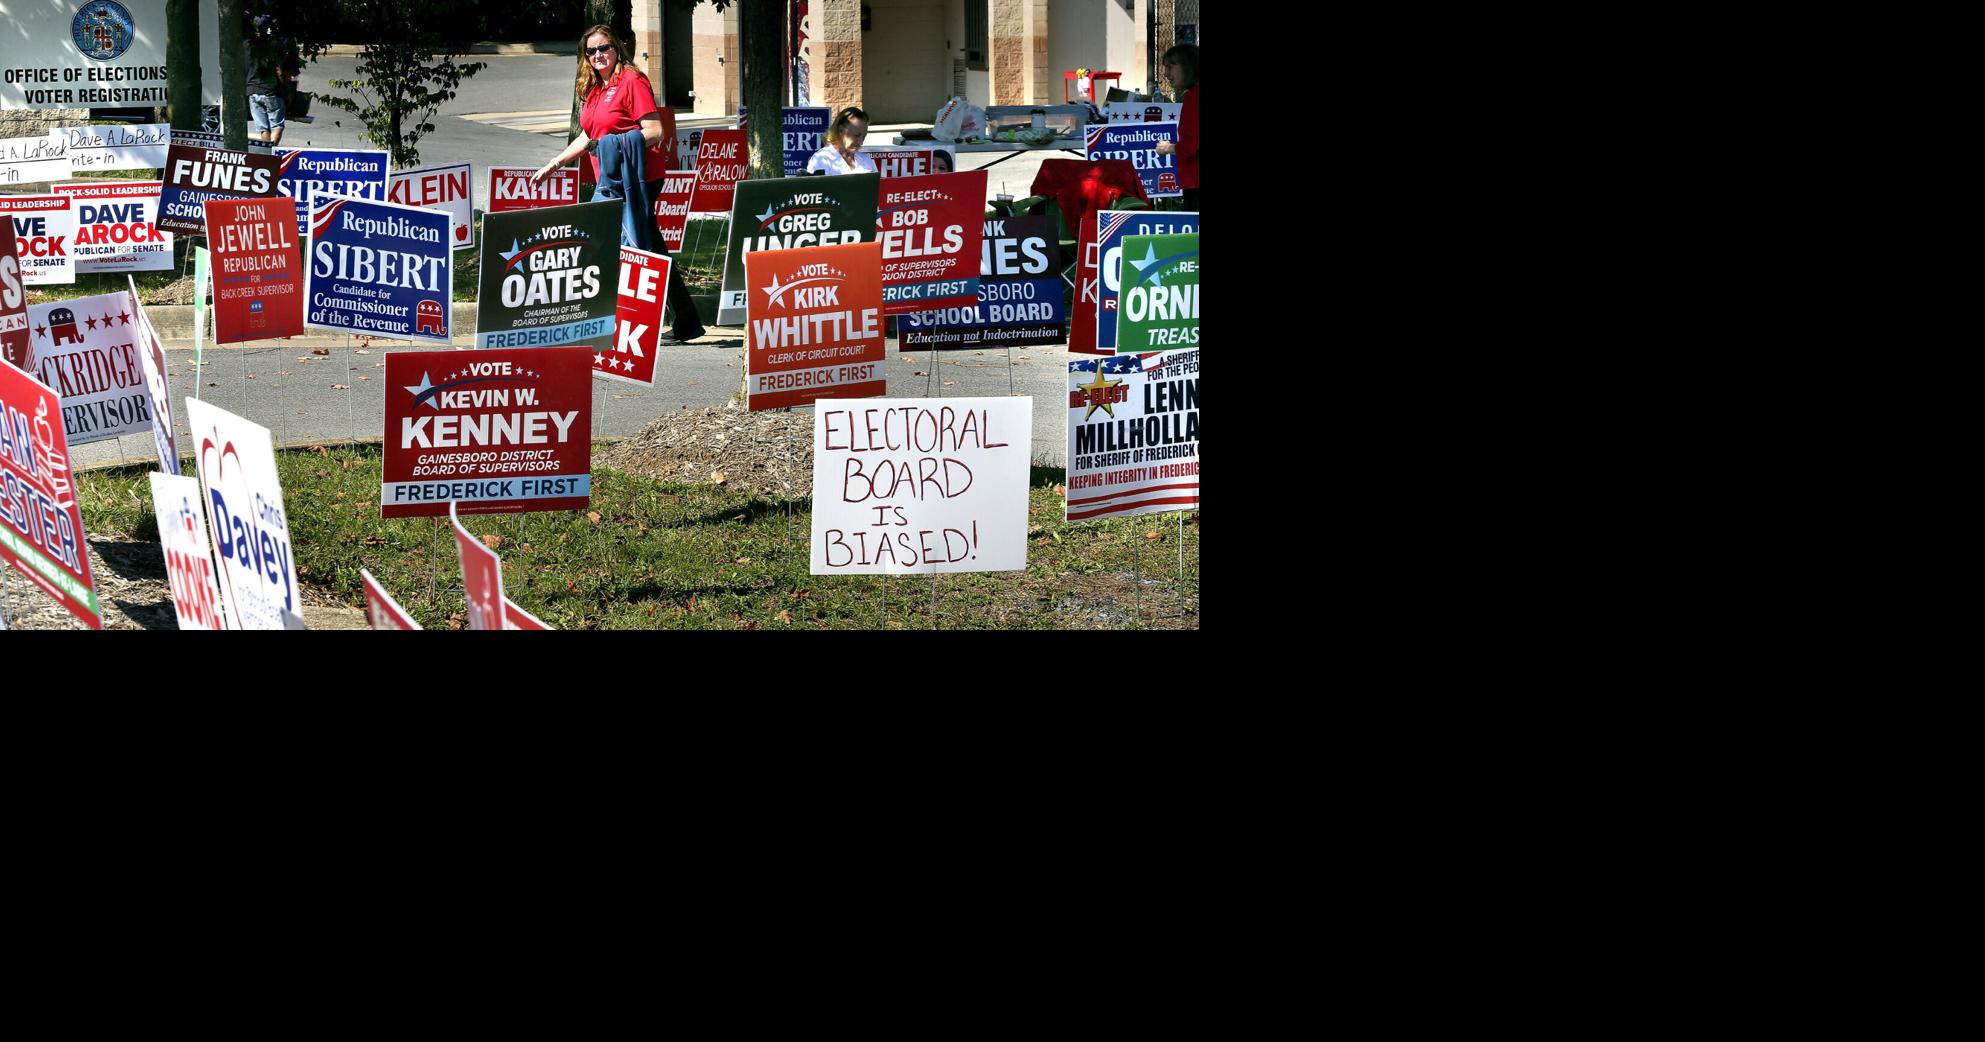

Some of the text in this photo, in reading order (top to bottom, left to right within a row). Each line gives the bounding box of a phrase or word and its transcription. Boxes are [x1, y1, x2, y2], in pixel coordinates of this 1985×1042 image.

[5, 66, 167, 83] OFFICE OF ELECTIONS
[25, 87, 168, 104] VOTER REGISTRATI
[70, 129, 102, 147] Dave
[121, 127, 165, 145] LaRock
[199, 140, 218, 149] BILL
[1106, 130, 1171, 146] Republican
[24, 138, 69, 160] LaRock
[205, 150, 247, 165] FRANK
[700, 142, 739, 159] DELANE
[72, 153, 115, 166] rite-in
[298, 157, 379, 174] Republican
[172, 159, 272, 194] FUNES
[388, 171, 467, 207] KLEIN
[886, 190, 937, 203] RE-ELECT
[12, 199, 65, 209] LEADERSHIP
[659, 201, 689, 216] Board
[794, 193, 822, 206] VOTE
[80, 203, 144, 225] DAVE
[166, 203, 205, 219] SCHO
[234, 205, 266, 222] JOHN
[892, 209, 928, 227] BOB
[13, 217, 46, 237] VE
[161, 218, 199, 230] Education
[342, 210, 440, 243] Republican
[542, 224, 572, 240] VOTE
[779, 212, 832, 233] GREG
[74, 222, 165, 246] AROCK
[217, 222, 291, 254] JEWELL
[74, 244, 164, 256] PUBLICAN FOR SENATE
[529, 246, 582, 272] GARY
[619, 251, 649, 266] DIDATE
[980, 237, 1049, 276] NES
[33, 258, 66, 267] SENATE
[224, 254, 286, 273] REPUBLICAN
[314, 241, 446, 292] SIBERT
[801, 263, 828, 277] VOTE
[885, 258, 957, 272] OF SUPERVISORS
[250, 275, 260, 283] FOR
[882, 267, 946, 281] QUON DISTRICT
[221, 284, 294, 300] BACK CREEK SUPERVISOR
[333, 284, 392, 299] Candidate for
[501, 265, 601, 308] OATES
[882, 281, 968, 301] ERICK FIRST
[314, 292, 409, 317] Commissioner
[794, 285, 840, 310] KIRK
[311, 309, 409, 333] of the Revenue
[512, 310, 589, 327] BOARD OF SUPERVISORS
[523, 304, 581, 318] CHAIRMAN OF THE
[909, 302, 1054, 327] SCHOOL BOARD
[486, 328, 570, 349] FREDERICK
[574, 319, 605, 340] FIRST
[753, 308, 879, 350] WHITTLE
[906, 327, 1059, 344] Education not Indoctrination
[1147, 326, 1199, 346] TREAS
[768, 344, 866, 364] CLERK OF CIRCUIT COURT
[1160, 357, 1166, 368] A
[469, 361, 512, 376] VOTE
[759, 364, 875, 392] FREDERICK FIRST
[1147, 361, 1199, 381] FOR THE PEO
[441, 388, 539, 409] KEVIN W.
[1069, 384, 1130, 409] RE-ELECT
[1144, 379, 1199, 415] LENN
[64, 394, 151, 436] ERVISOR
[401, 410, 579, 449] KENNEY
[825, 406, 1008, 453] ELECTORAL
[1076, 411, 1199, 456] MILLHOLLA
[417, 449, 554, 465] GAINESBORO DISTRICT
[1075, 443, 1196, 471] FOR SHERIFF OF FREDERICK
[412, 460, 561, 476] BOARD OF SUPERVISORS
[1068, 461, 1199, 490] KEEPING INTEGRITY IN FREDERIC
[394, 478, 579, 502] FREDERICK FIRST
[843, 457, 973, 503] BOARD
[871, 505, 908, 526] IS
[210, 487, 293, 612] Davey
[825, 520, 978, 567] BIASED!
